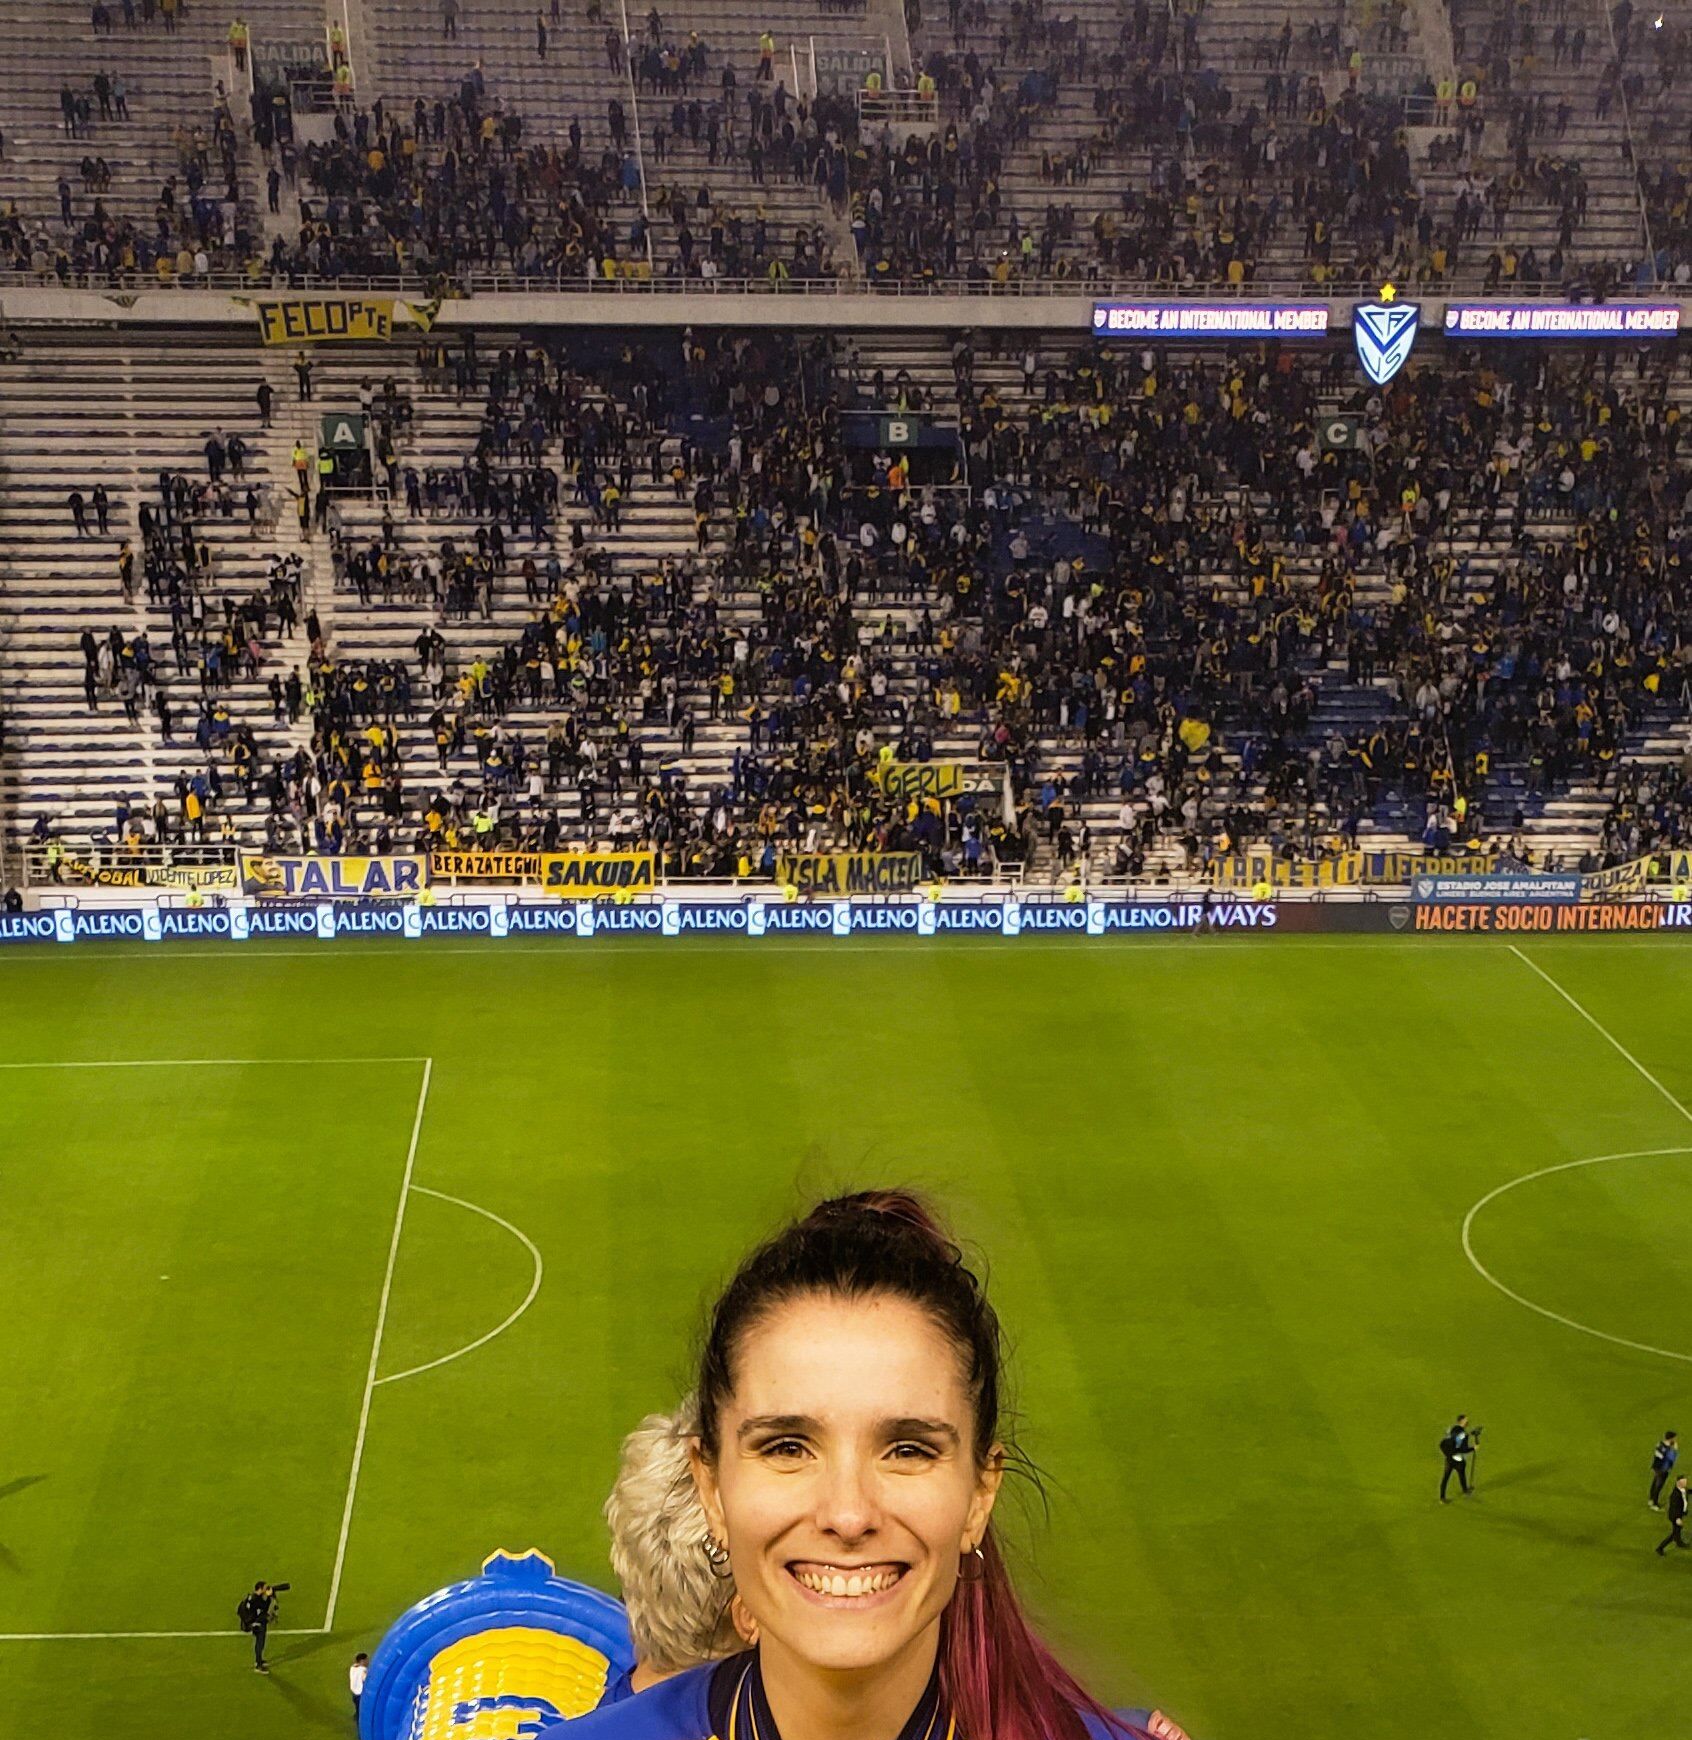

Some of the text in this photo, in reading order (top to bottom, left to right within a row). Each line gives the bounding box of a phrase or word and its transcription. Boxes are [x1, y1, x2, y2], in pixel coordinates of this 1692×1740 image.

[254, 45, 325, 61] SALIDA
[817, 56, 884, 73] SALIDA
[1108, 310, 1328, 330] BECOME AN INTERNATIONAL MEMBER
[1460, 310, 1679, 330] BECOME AN INTERNATIONAL MEMBER
[333, 422, 356, 442] A
[888, 422, 909, 442] B
[1327, 422, 1348, 443] C
[883, 765, 961, 796] GERLI
[277, 860, 420, 893] TALAR
[1171, 904, 1277, 927] IRWAYS
[1415, 905, 1491, 930] HACETE
[1494, 905, 1553, 930] SOCIO
[0, 916, 54, 938] LENO
